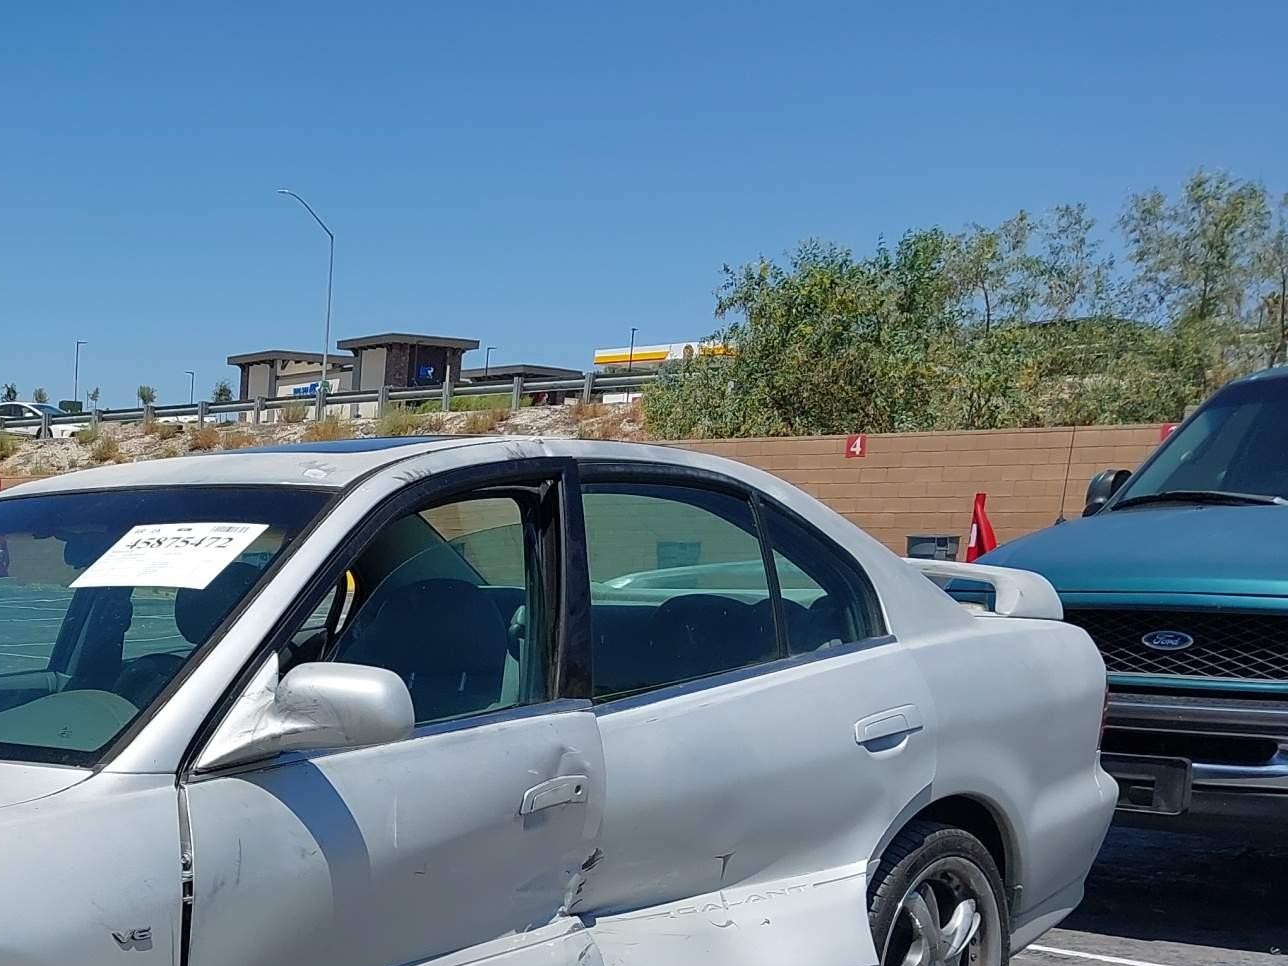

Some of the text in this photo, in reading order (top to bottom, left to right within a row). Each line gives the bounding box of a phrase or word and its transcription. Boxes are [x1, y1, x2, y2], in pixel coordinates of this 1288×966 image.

[849, 436, 862, 456] 4
[125, 536, 234, 549] 45875472
[111, 926, 152, 944] V6
